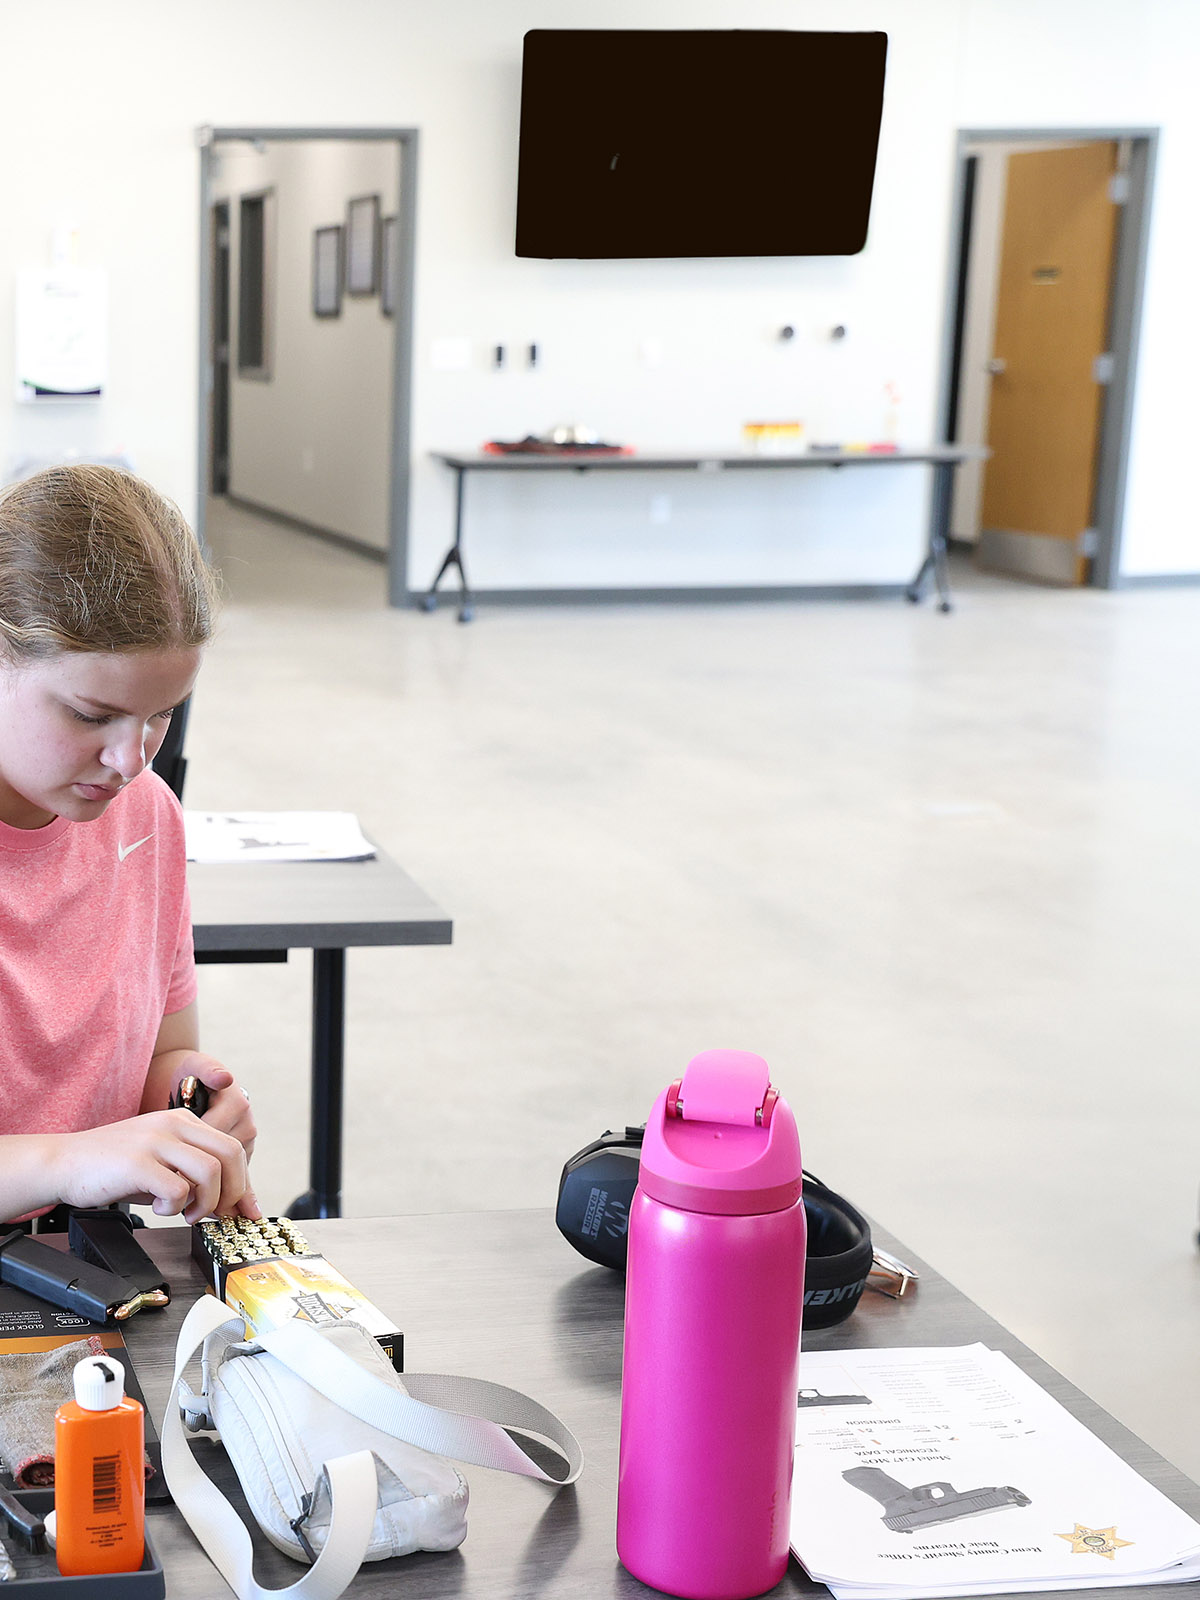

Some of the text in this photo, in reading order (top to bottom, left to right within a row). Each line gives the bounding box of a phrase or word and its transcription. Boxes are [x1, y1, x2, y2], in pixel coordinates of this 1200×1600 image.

[584, 1195, 597, 1228] RAZOR
[845, 1418, 901, 1426] DIMENSION
[854, 1449, 882, 1457] DATA
[860, 1454, 951, 1465] Model G47 MOS
[912, 1541, 999, 1552] Basic Firearms
[876, 1546, 1042, 1561] Reno County Sheriff's Office
